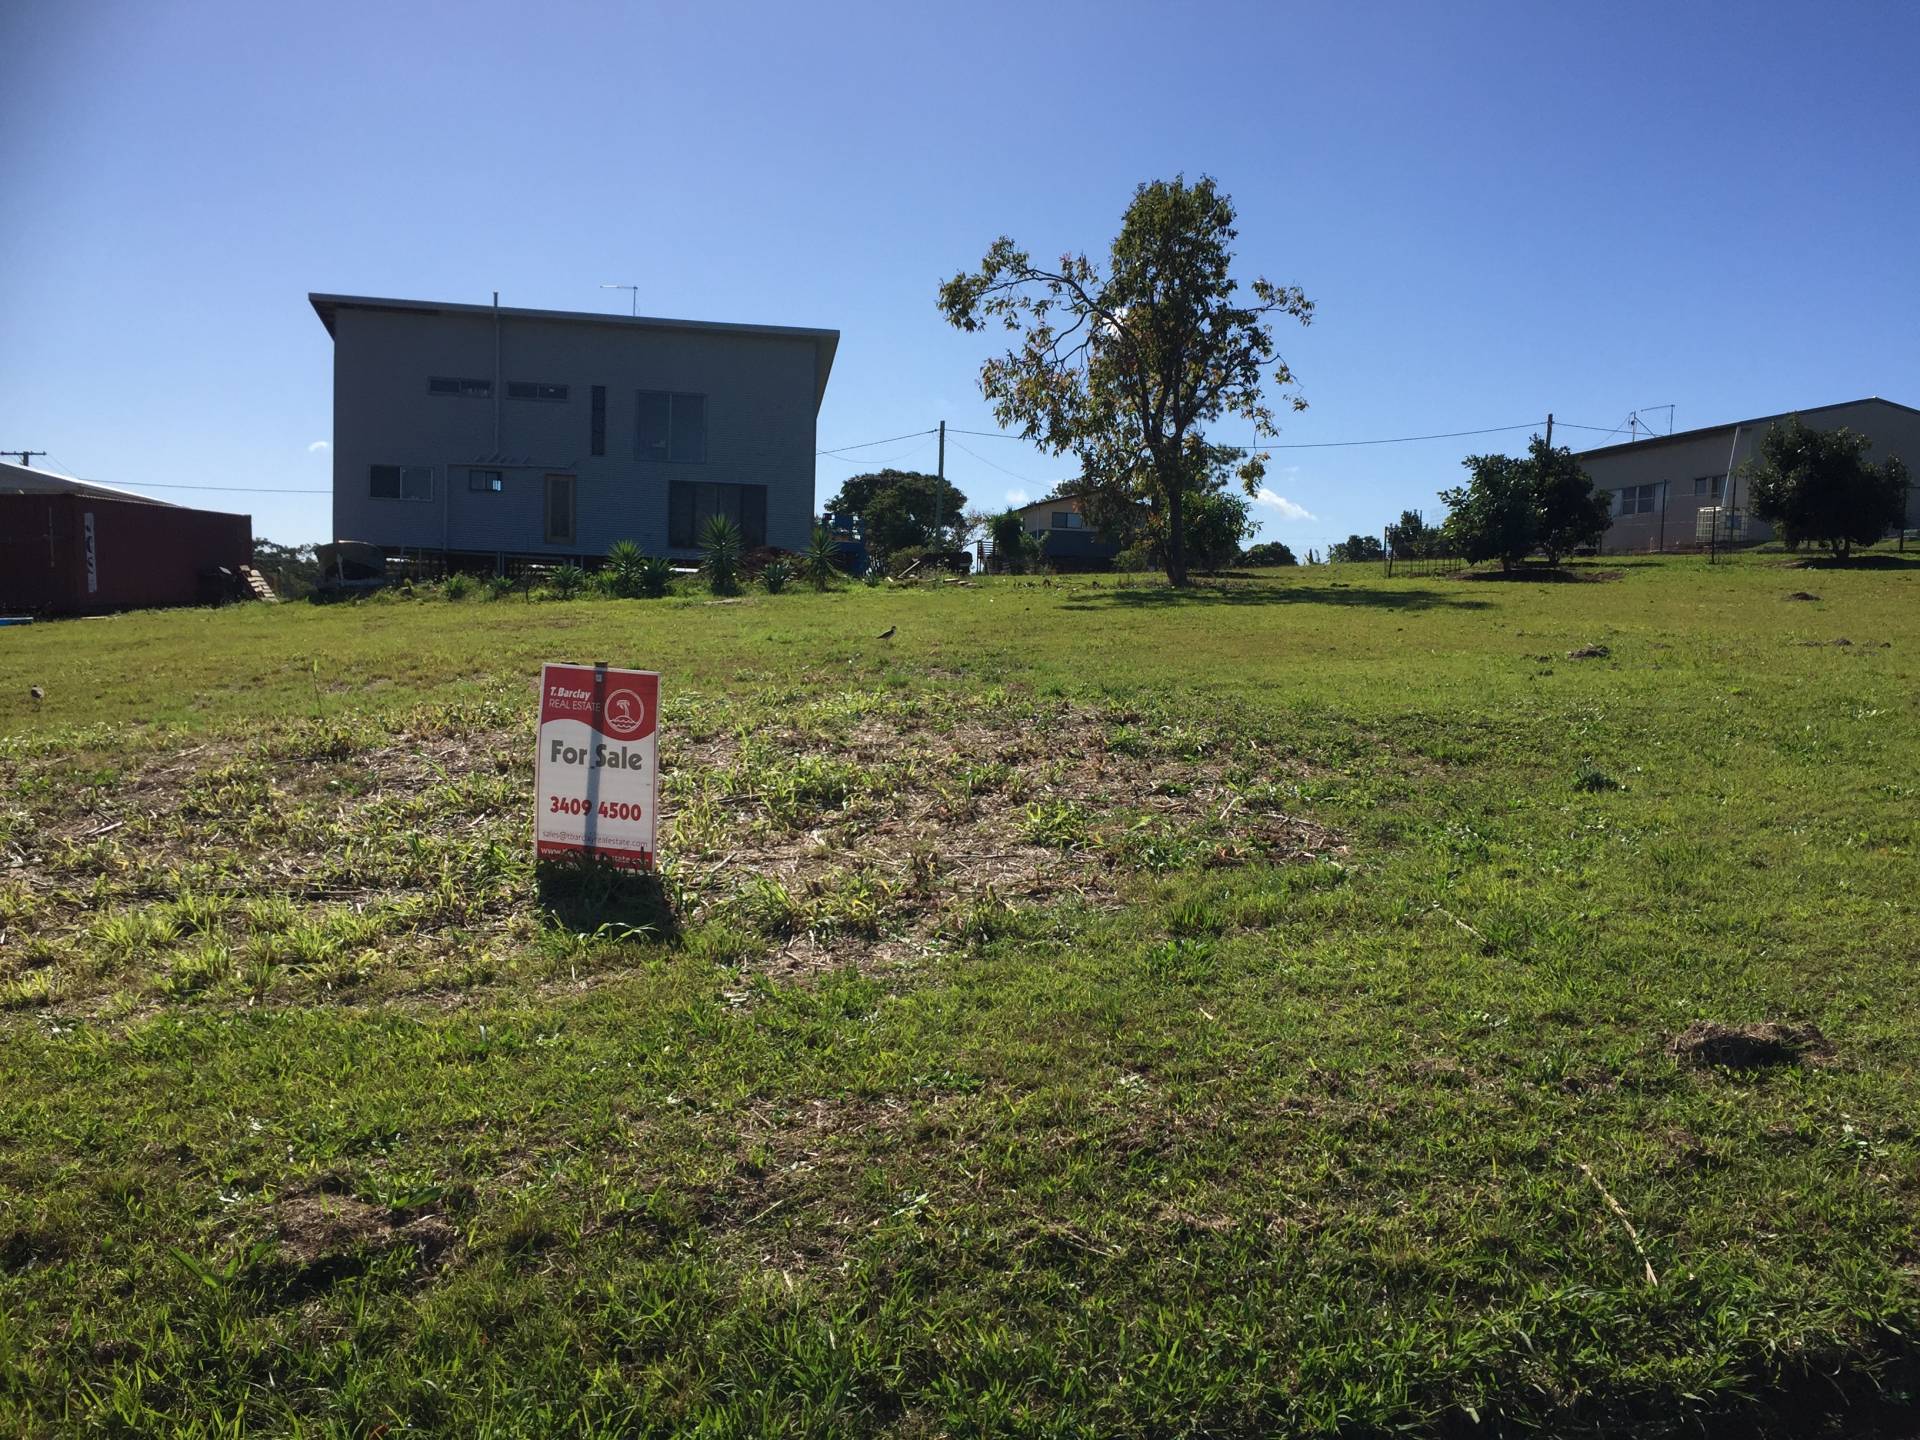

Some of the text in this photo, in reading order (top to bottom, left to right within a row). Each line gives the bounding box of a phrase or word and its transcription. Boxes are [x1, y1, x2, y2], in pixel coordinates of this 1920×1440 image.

[549, 698, 601, 712] REAL ESTATE
[551, 740, 643, 770] For Sale
[550, 796, 641, 821] 3409 4500
[542, 830, 648, 848] sales@tbarcyealestate.com
